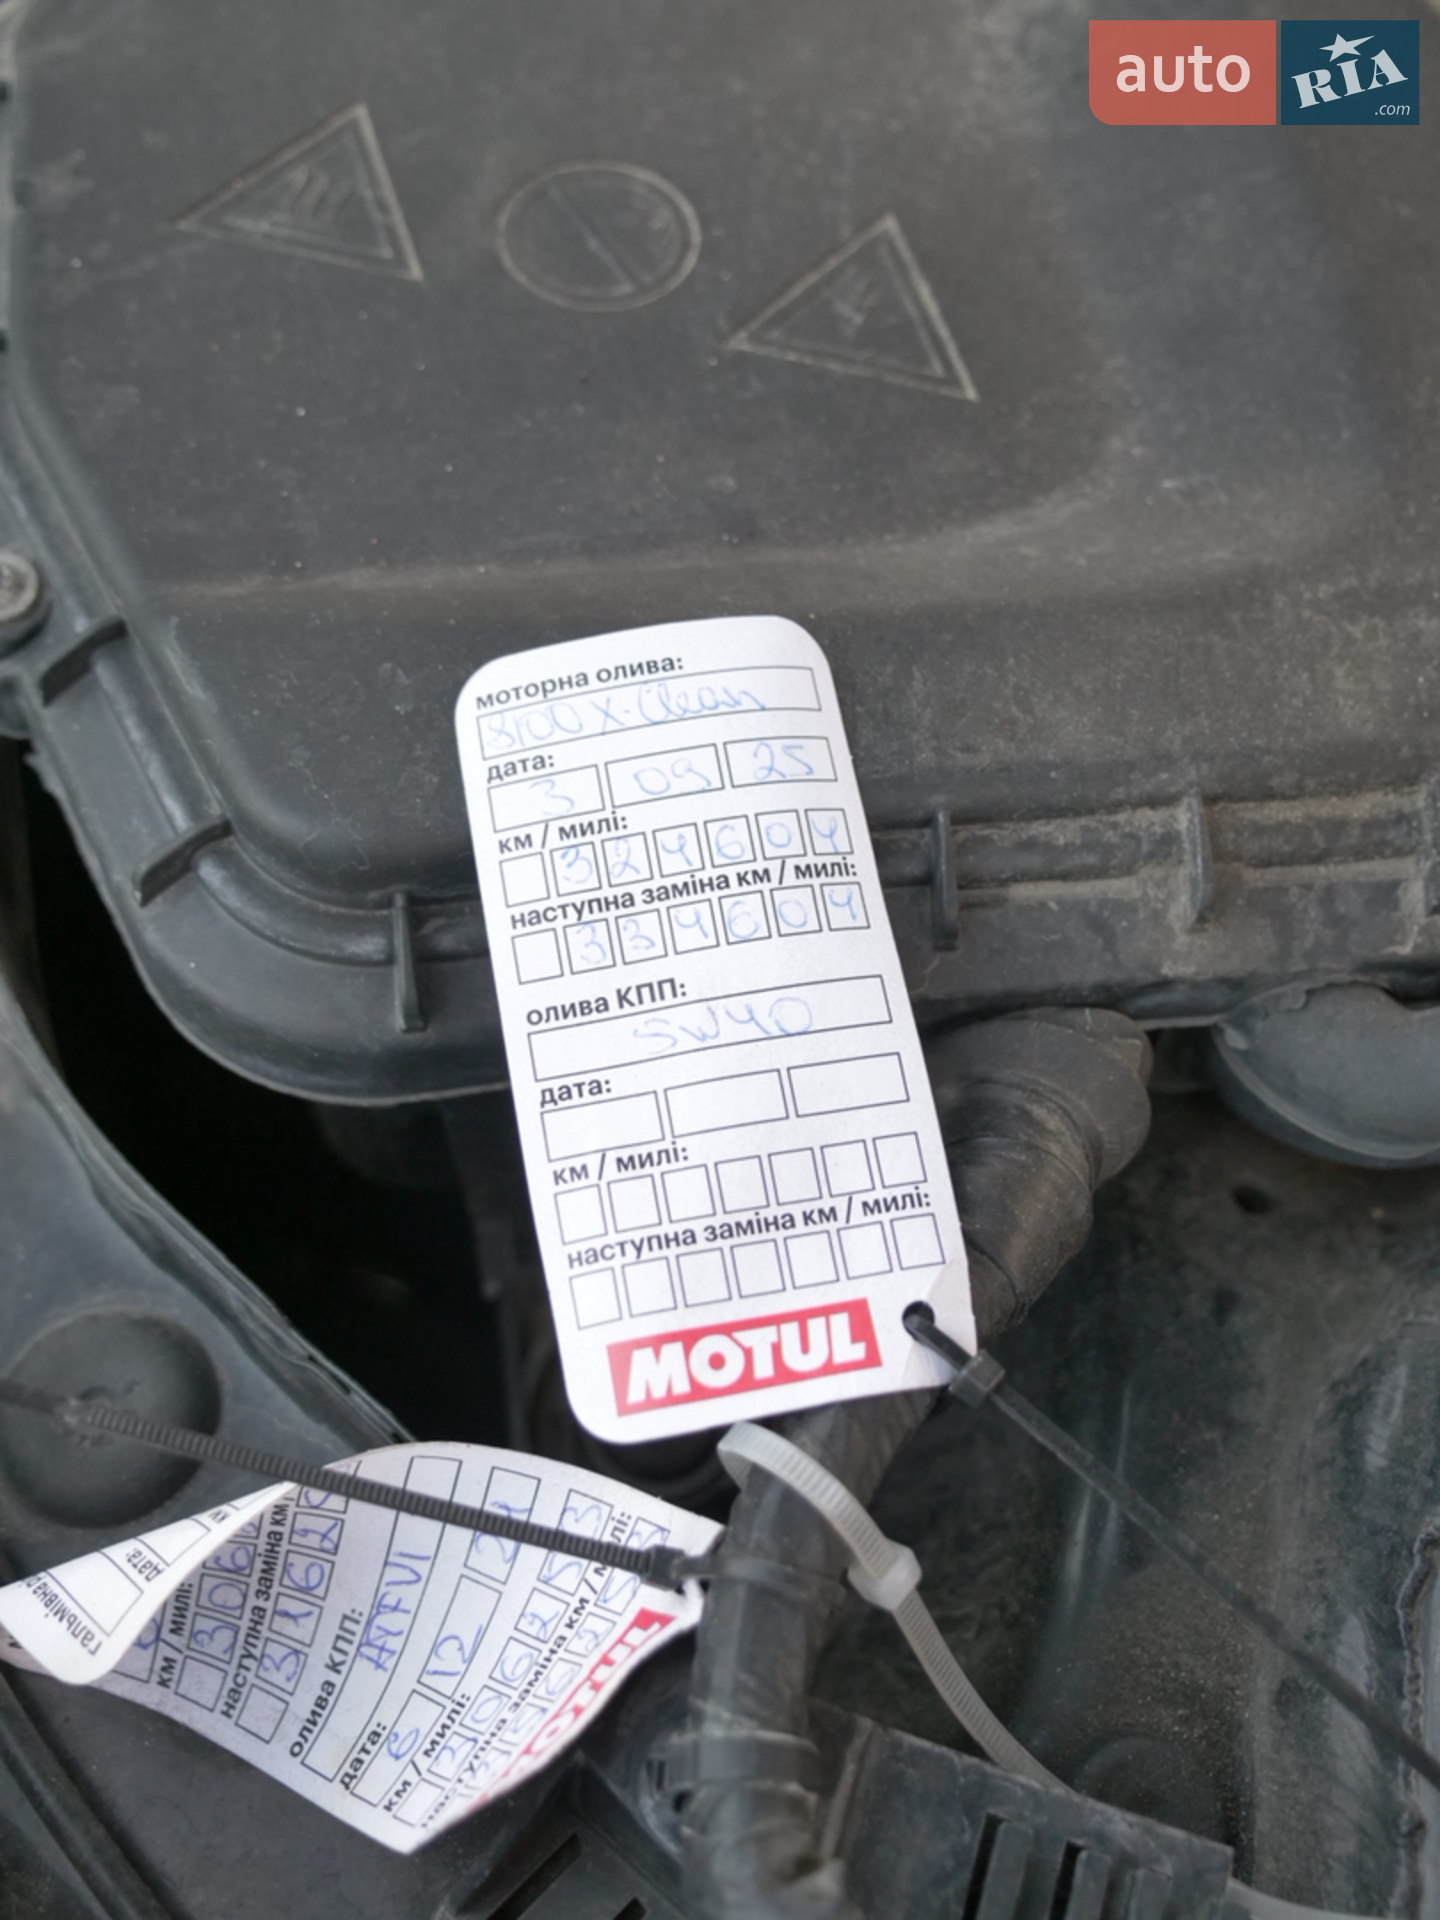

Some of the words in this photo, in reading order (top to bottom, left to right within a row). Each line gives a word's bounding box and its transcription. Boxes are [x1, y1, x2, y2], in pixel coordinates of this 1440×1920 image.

[475, 671, 589, 711] моторна
[596, 653, 684, 683] олива:
[487, 752, 555, 784] дата:
[753, 741, 814, 781] 25
[499, 831, 534, 855] км
[558, 811, 628, 842] милі:
[510, 888, 637, 931] наступна
[641, 874, 731, 904] заміна
[736, 867, 772, 887] км
[793, 856, 858, 881] милі:
[526, 993, 609, 1026] олива
[616, 978, 687, 1008] КПП:
[540, 1078, 613, 1108] дата:
[552, 1163, 590, 1186] км
[615, 1141, 689, 1174] милі:
[567, 1224, 698, 1270] наступна
[703, 1211, 797, 1244] заміна
[801, 1205, 839, 1228] км
[861, 1185, 932, 1218] милі:
[626, 1311, 869, 1407] MOTUL
[125, 1547, 165, 1583] дата:
[156, 1655, 178, 1689] км
[168, 1582, 194, 1637] милі:
[219, 1603, 268, 1720] наступна
[255, 1529, 284, 1602] заміна
[508, 1634, 568, 1714] заміна
[565, 1597, 590, 1629] км
[593, 1511, 632, 1578] млі:
[289, 1679, 336, 1759] олива
[325, 1606, 365, 1675] КПП:
[340, 1721, 387, 1790] дата:
[383, 1779, 413, 1812] км
[422, 1692, 470, 1759] милі:
